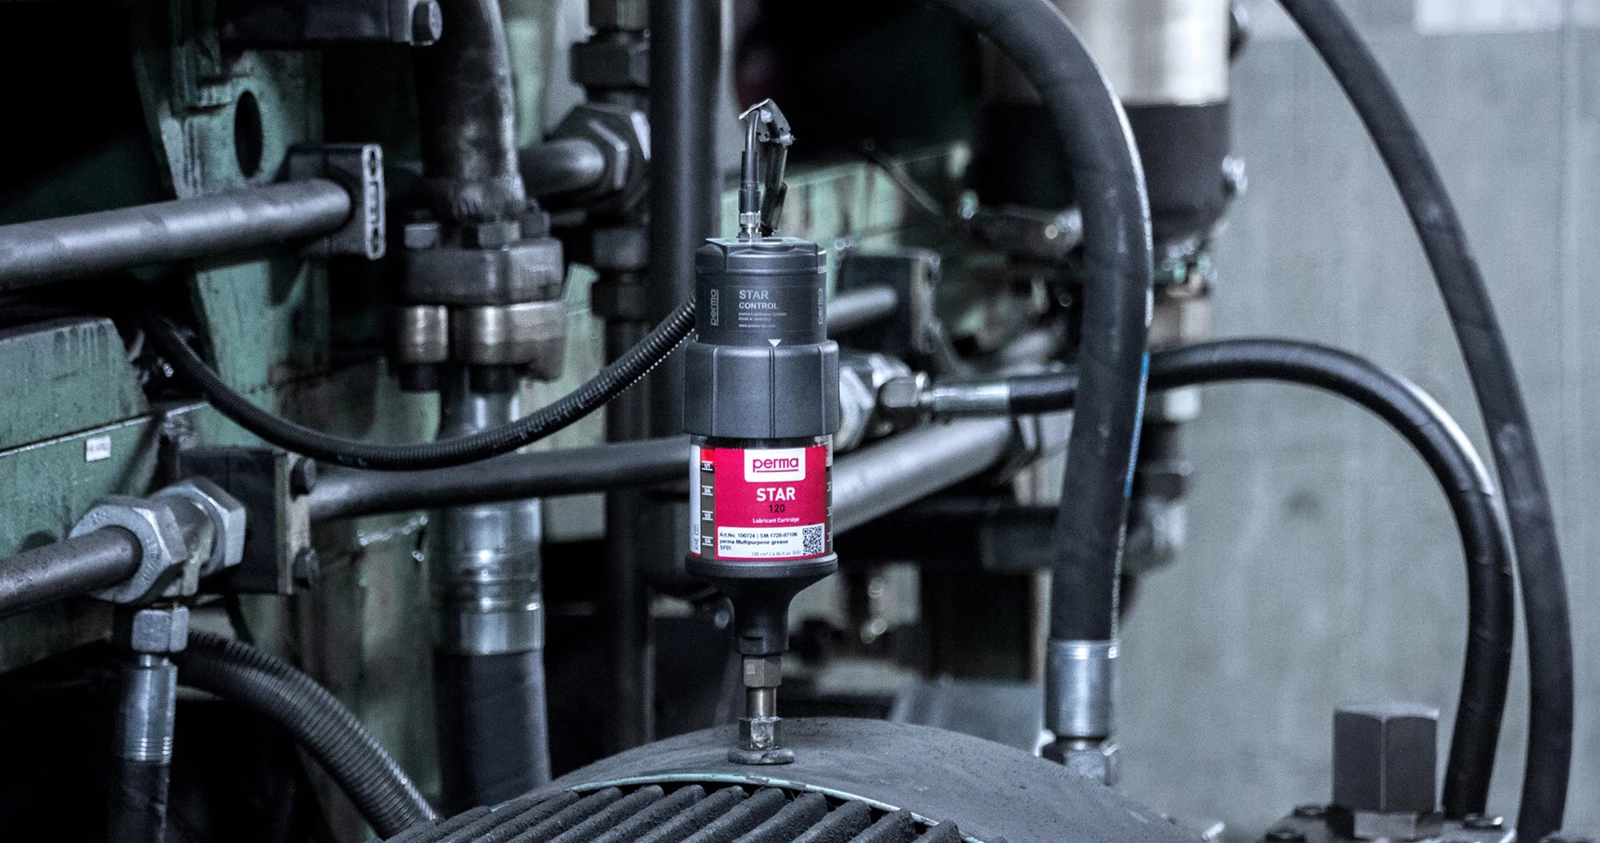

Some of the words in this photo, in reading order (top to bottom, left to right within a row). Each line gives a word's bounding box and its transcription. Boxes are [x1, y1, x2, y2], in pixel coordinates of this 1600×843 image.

[739, 290, 769, 300] STAR
[710, 289, 719, 326] perma
[739, 302, 778, 310] CONTROL
[753, 458, 799, 473] perma
[756, 487, 796, 501] STAR
[769, 504, 785, 513] 120
